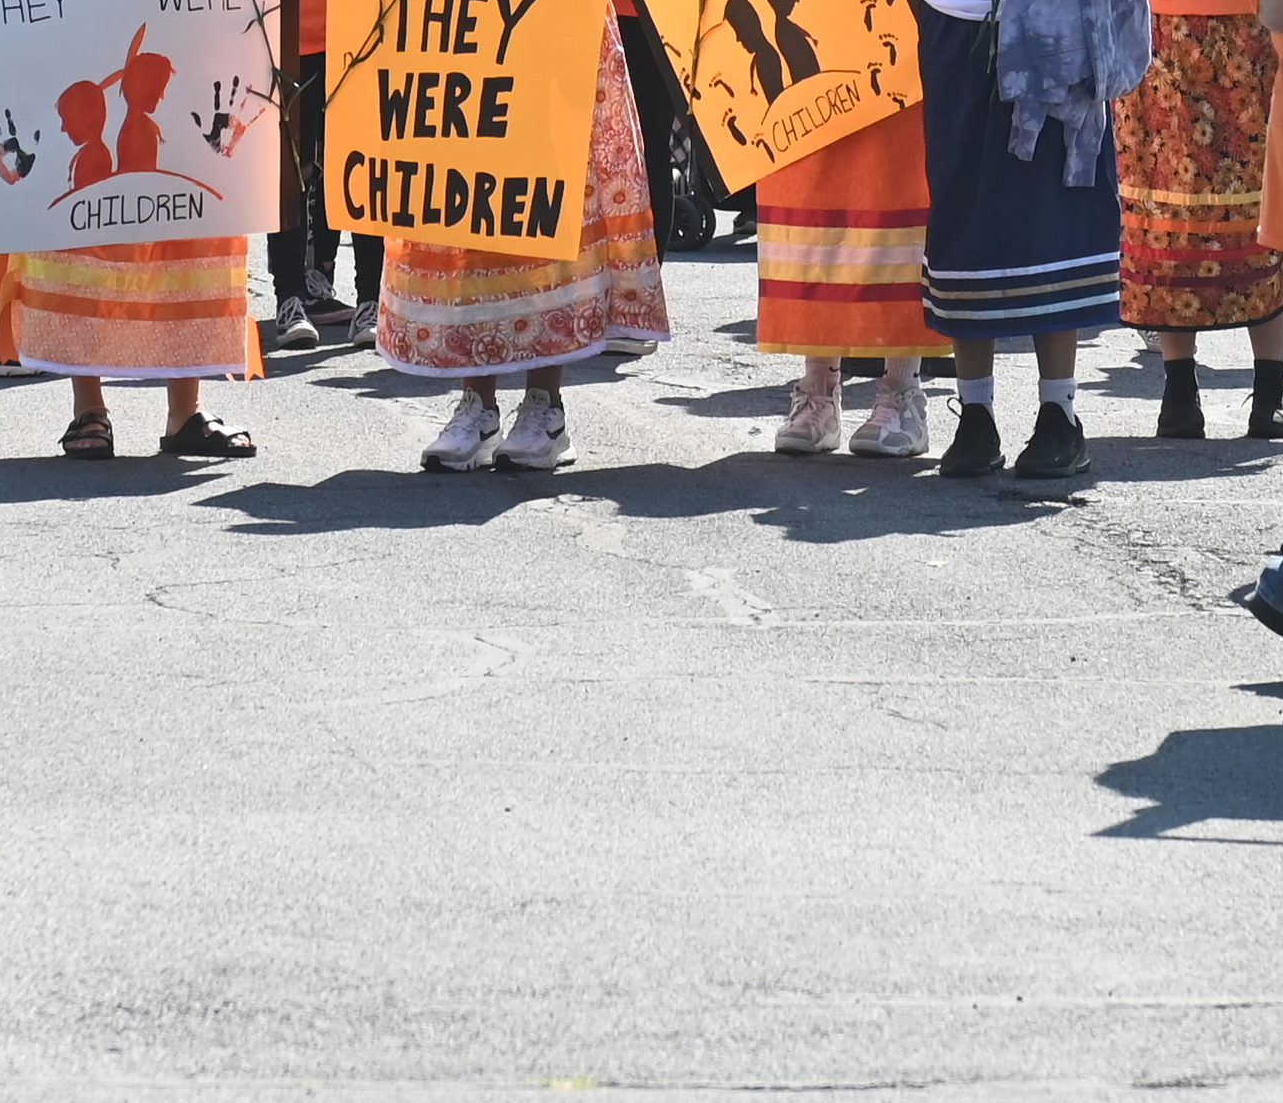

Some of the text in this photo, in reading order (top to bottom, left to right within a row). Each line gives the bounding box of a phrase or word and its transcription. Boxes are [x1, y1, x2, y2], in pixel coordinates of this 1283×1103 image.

[377, 68, 514, 142] WERE
[772, 79, 860, 153] CHILDREN
[70, 191, 204, 231] CHILDREN
[343, 150, 565, 238] CHILDREN
